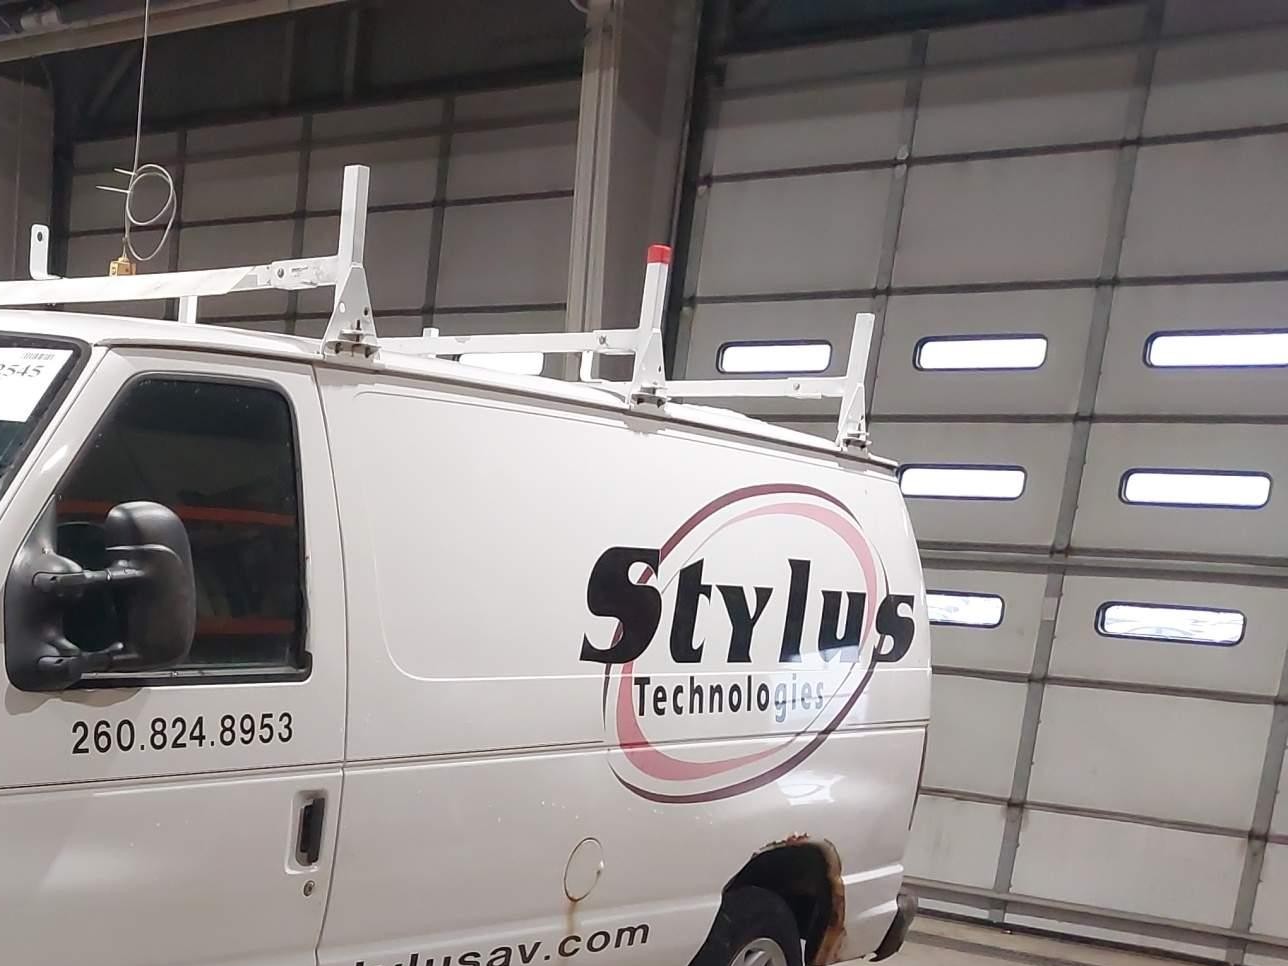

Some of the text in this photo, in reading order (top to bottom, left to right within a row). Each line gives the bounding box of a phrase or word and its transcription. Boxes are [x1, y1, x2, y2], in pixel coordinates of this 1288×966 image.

[579, 546, 915, 664] Stylus
[634, 674, 824, 722] Technologies
[71, 712, 293, 755] 260.824.8953
